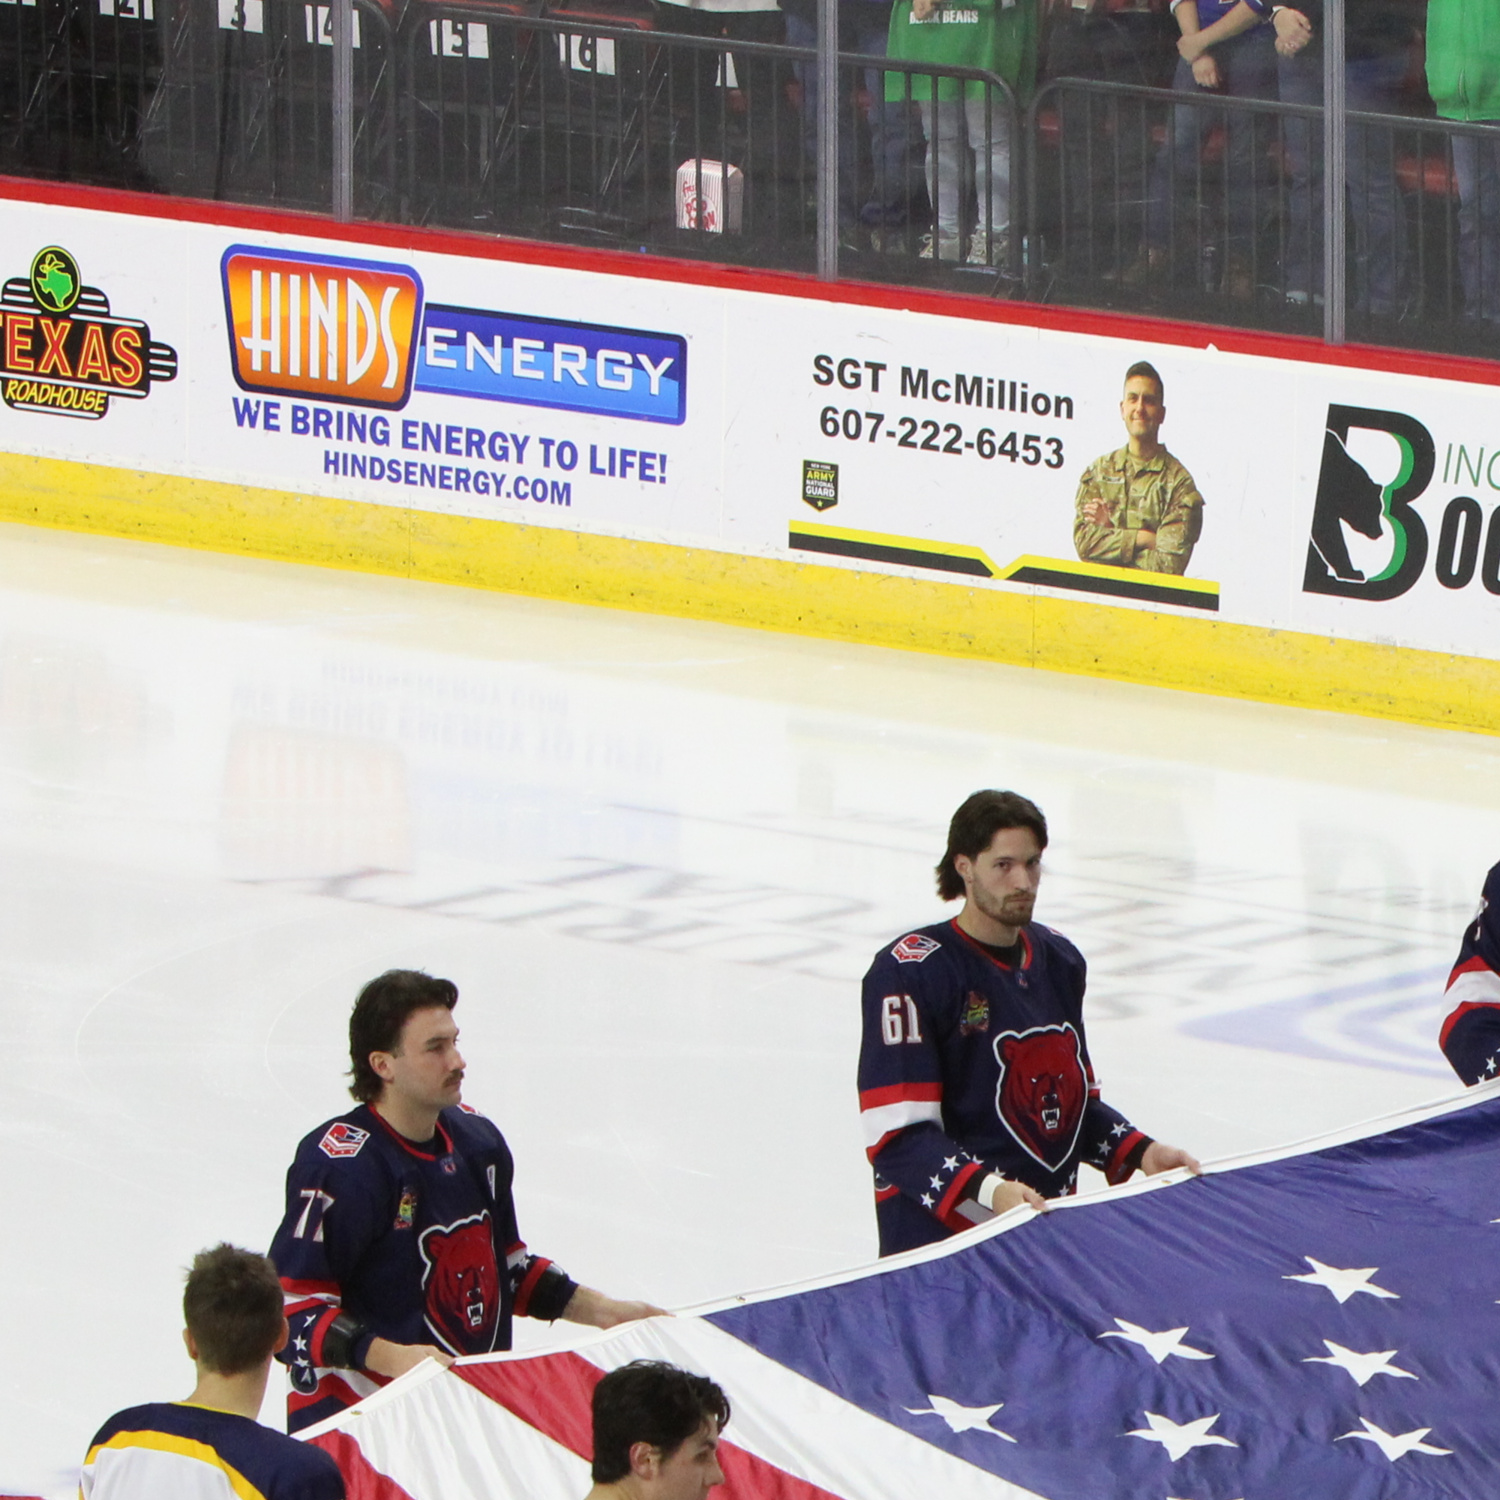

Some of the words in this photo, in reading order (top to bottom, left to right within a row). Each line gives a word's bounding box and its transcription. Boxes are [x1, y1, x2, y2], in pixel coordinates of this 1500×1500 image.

[943, 10, 979, 23] BEARS
[241, 268, 400, 390] HINDS
[424, 328, 675, 397] ENERGY
[6, 379, 106, 412] ROADHOUSE
[812, 354, 887, 393] SGT
[900, 365, 1075, 420] McMillion
[232, 397, 280, 431] WE
[291, 405, 391, 446] BRING
[401, 419, 530, 464] ENERGY
[538, 437, 577, 471] TO
[589, 445, 668, 484] LIFE!
[819, 406, 1065, 469] 607-222-6453
[323, 450, 572, 507] HINDSENERGY.COM
[806, 479, 834, 489] NATIONAL
[806, 486, 835, 498] GUARD
[807, 471, 834, 482] ARMY
[882, 995, 922, 1044] 61
